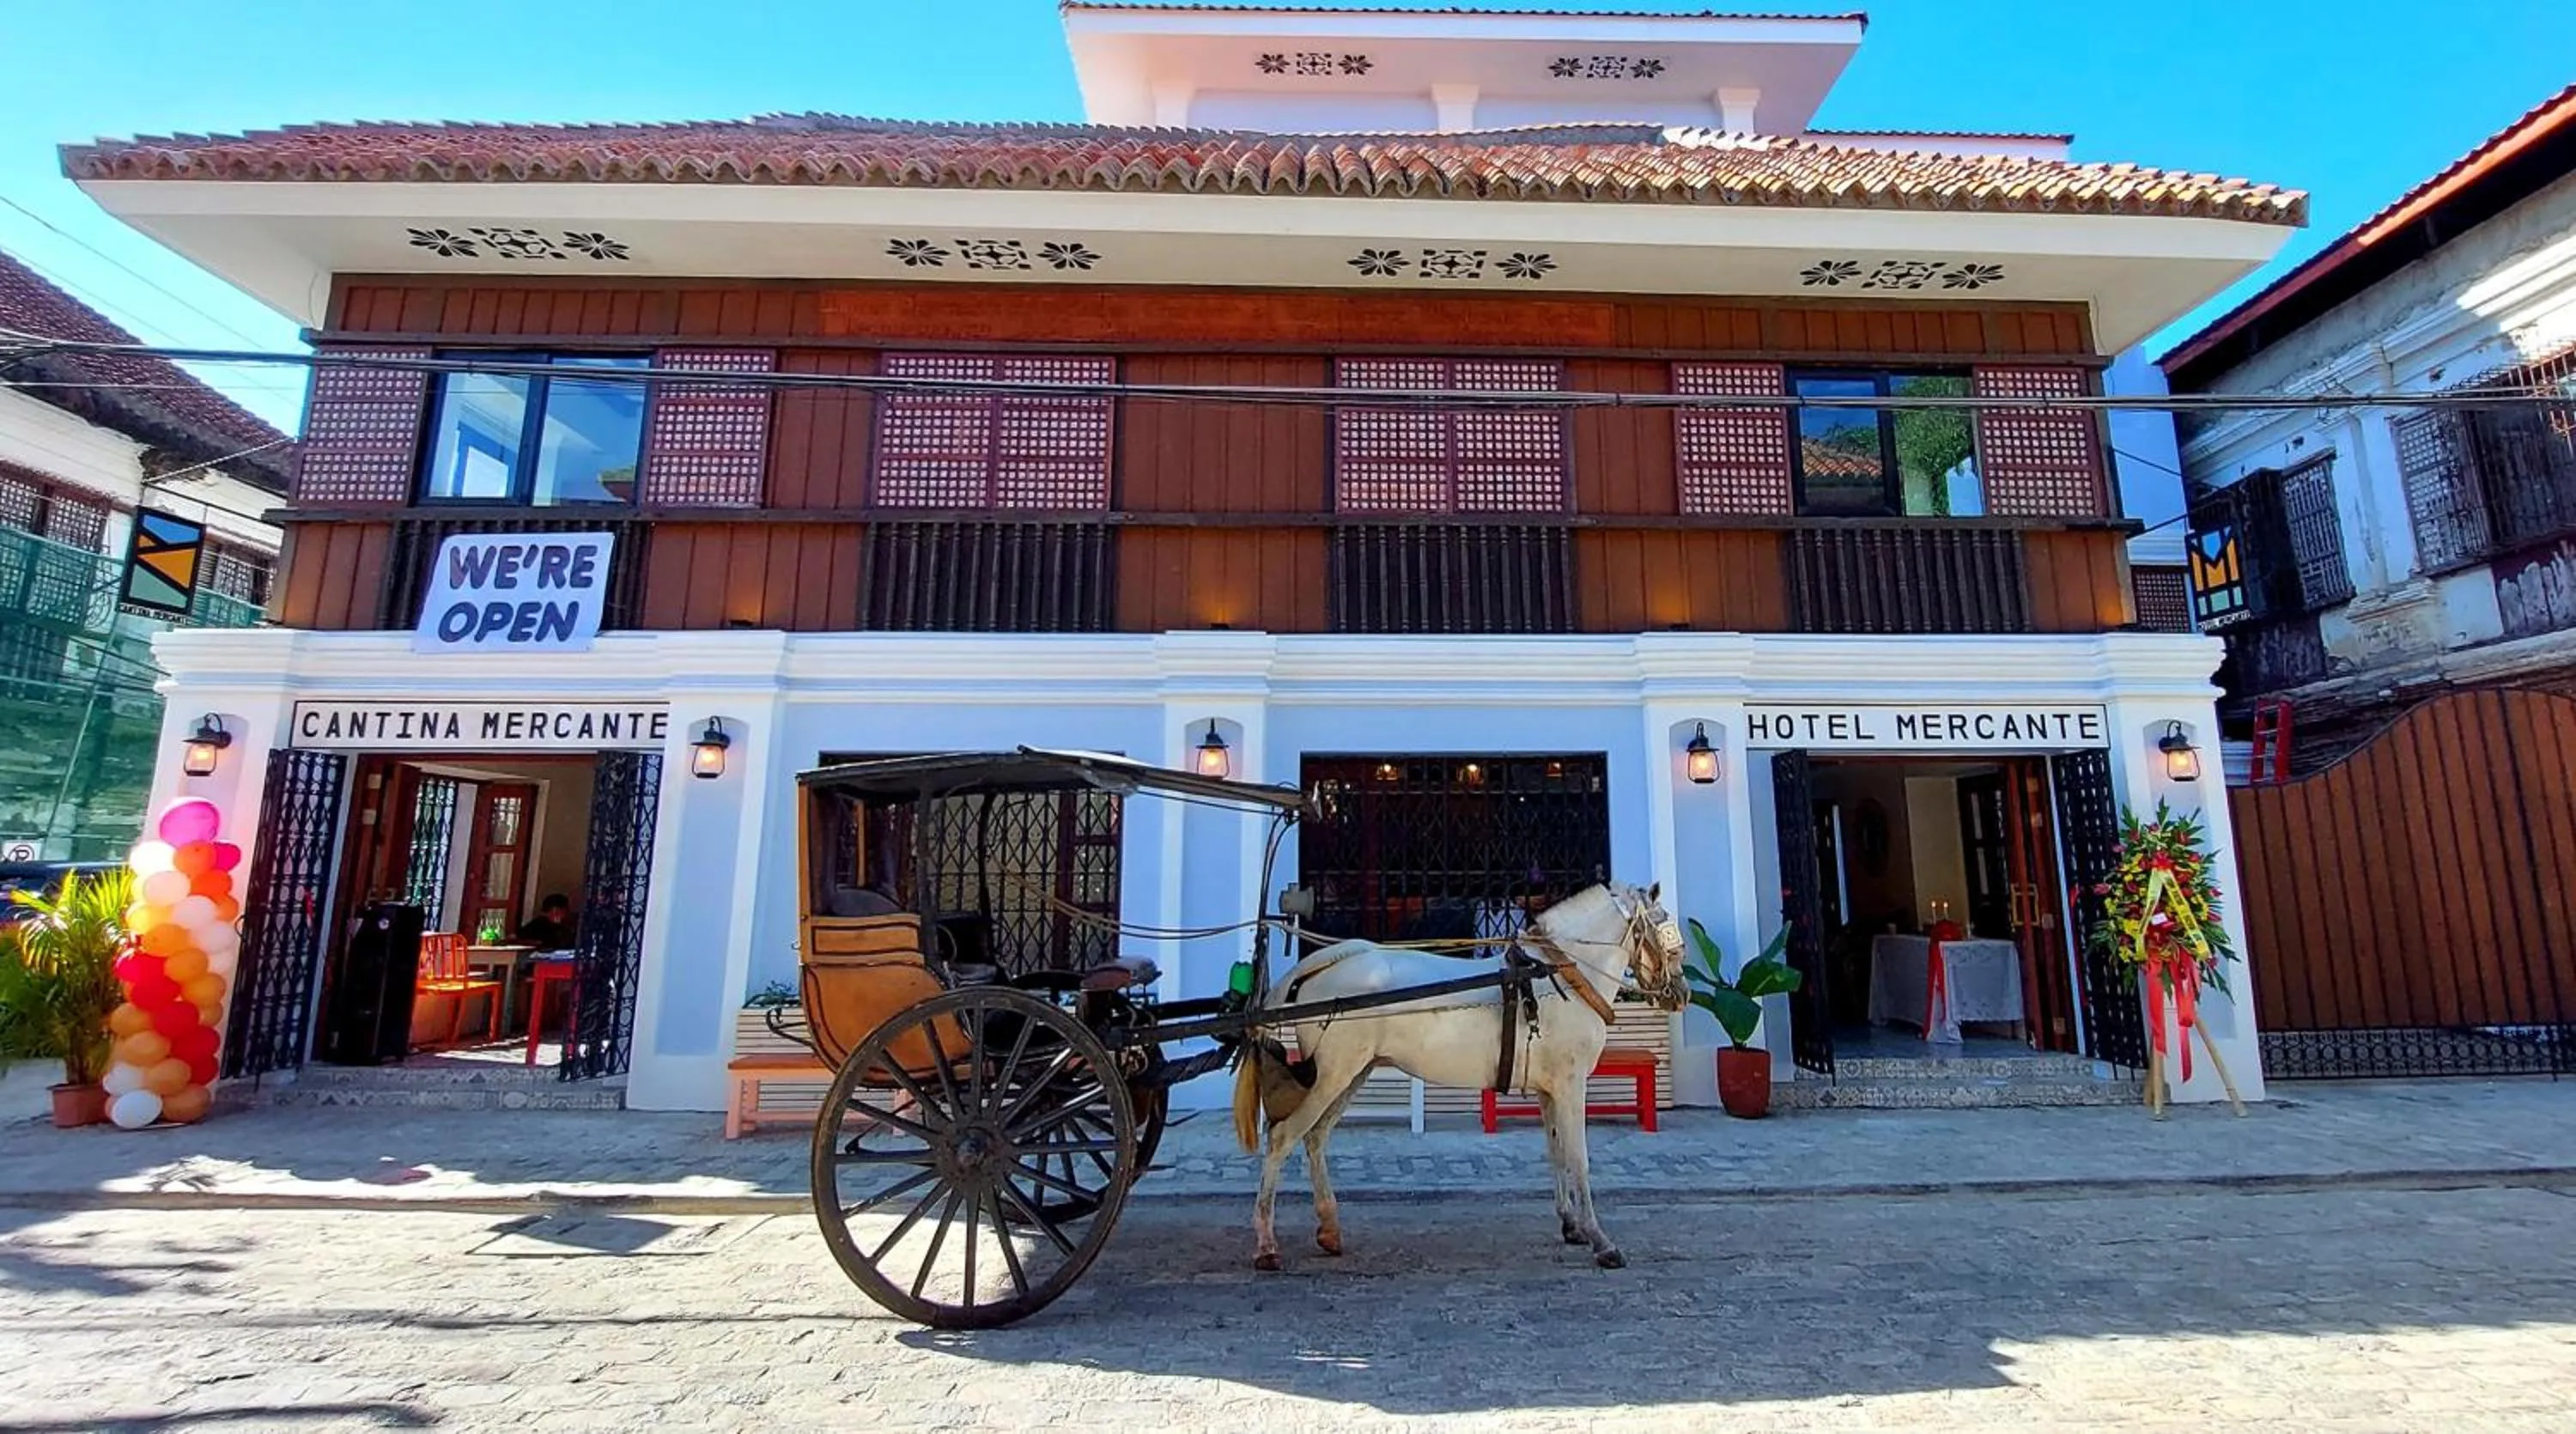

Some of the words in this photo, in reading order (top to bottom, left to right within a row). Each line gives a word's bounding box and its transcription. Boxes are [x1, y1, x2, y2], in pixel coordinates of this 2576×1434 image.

[449, 544, 598, 590] WE'RE
[437, 600, 580, 642] OPEN
[301, 711, 461, 739] CANTINA
[481, 711, 670, 740] MERCANTE
[1747, 714, 1876, 739] HOTEL
[1896, 713, 2100, 740] MERCANTE
